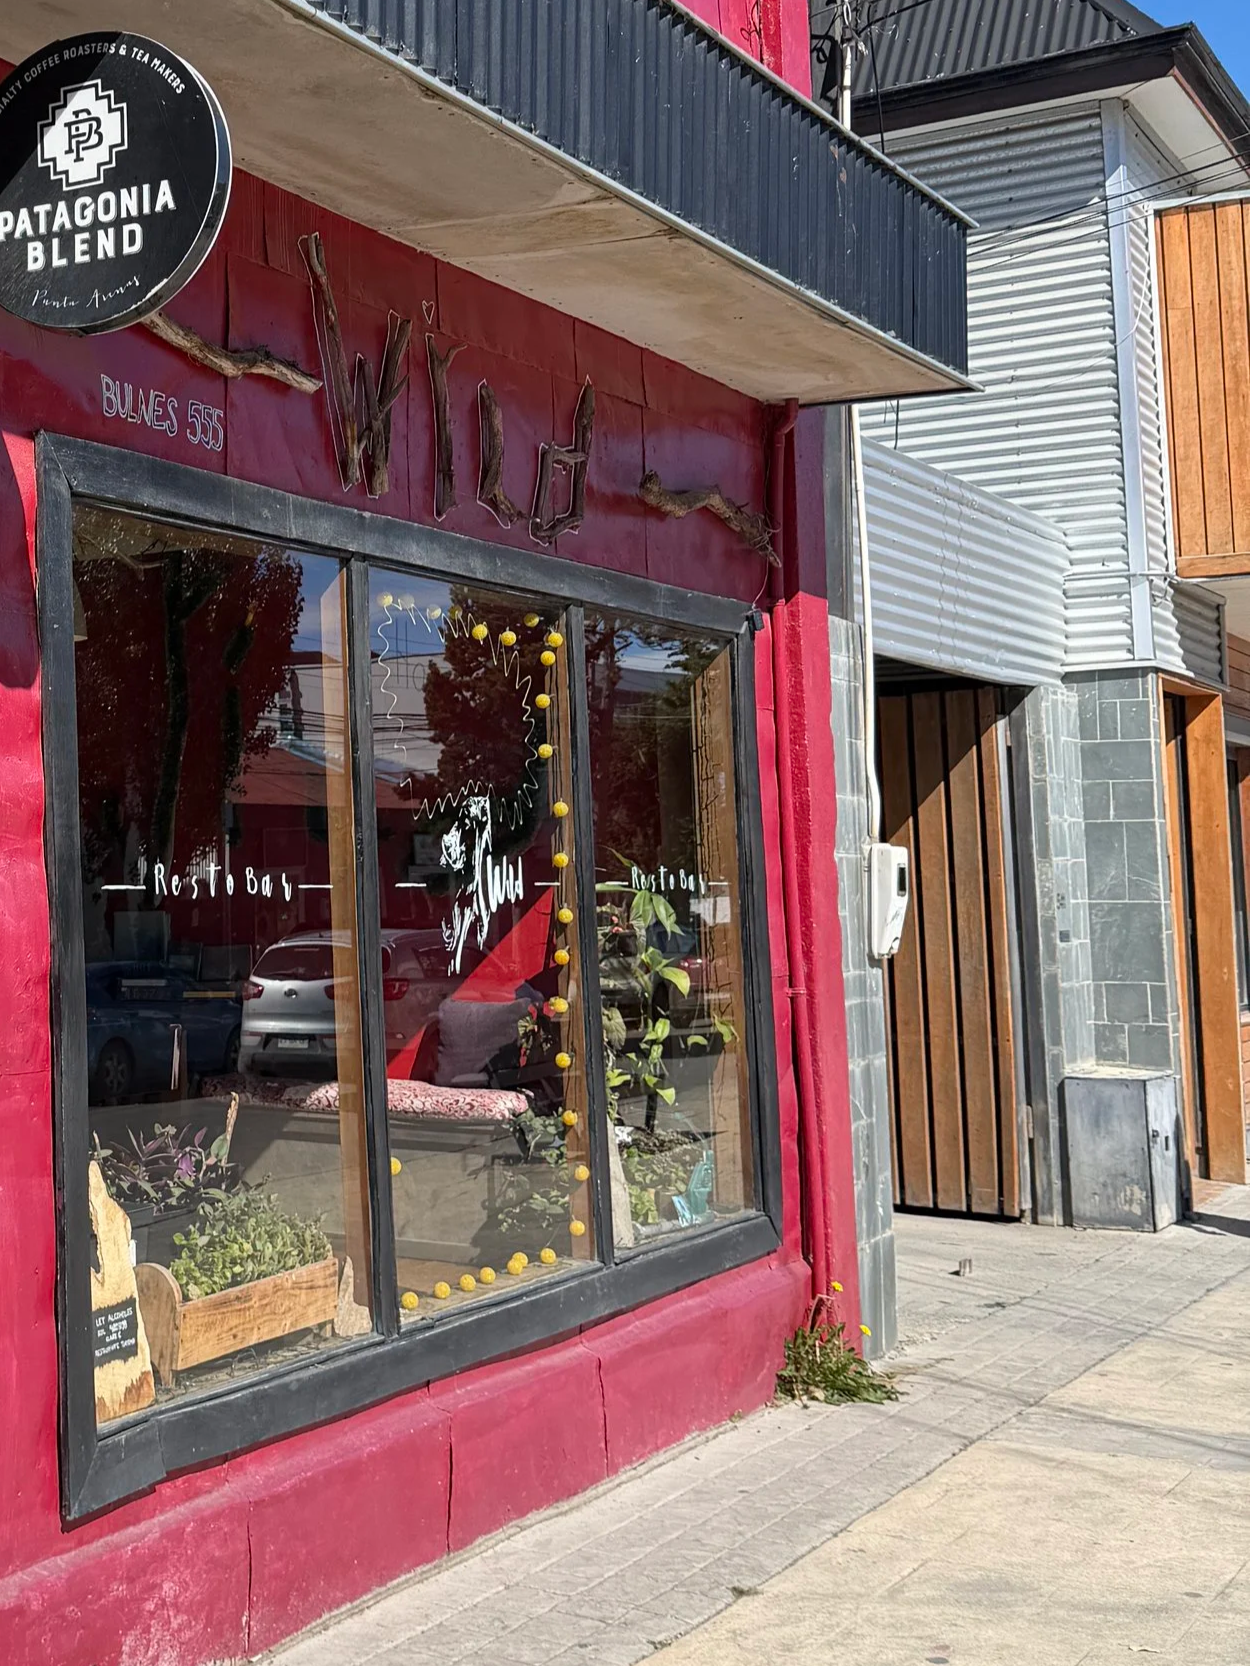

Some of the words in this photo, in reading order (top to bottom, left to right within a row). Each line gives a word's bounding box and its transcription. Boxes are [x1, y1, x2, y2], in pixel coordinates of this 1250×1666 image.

[24, 54, 61, 84] COFFEE
[62, 43, 117, 62] ROASTERS
[119, 44, 127, 56] &
[130, 46, 150, 64] TEA
[150, 57, 187, 95] MAKERS
[26, 222, 144, 272] BLEND
[100, 373, 178, 437] BULNES
[186, 399, 224, 452] 555
